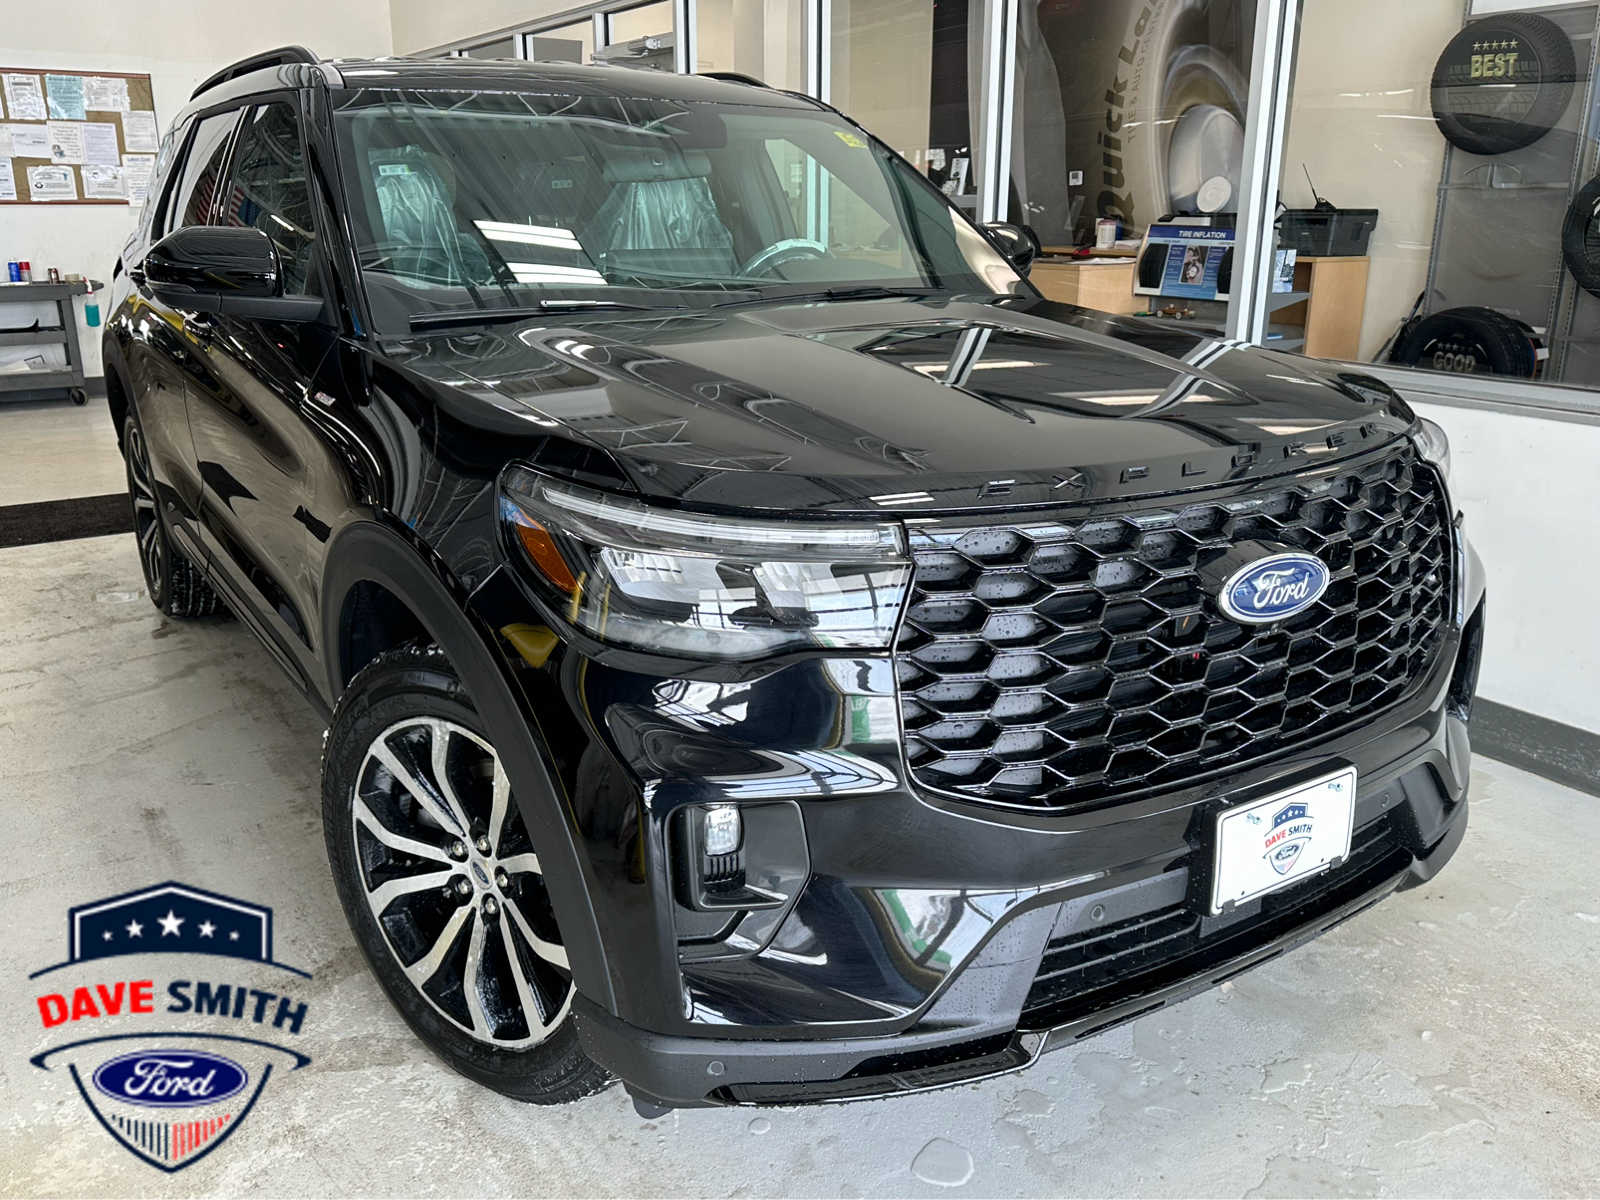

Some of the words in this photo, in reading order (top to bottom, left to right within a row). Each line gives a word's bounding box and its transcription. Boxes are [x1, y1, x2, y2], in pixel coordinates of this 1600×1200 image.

[1471, 53, 1519, 78] BEST
[1433, 351, 1476, 372] GOOD
[977, 423, 1376, 500] EXPLORER
[1253, 568, 1310, 608] Ford
[1265, 829, 1286, 848] DAVE
[1288, 824, 1312, 836] SMITH
